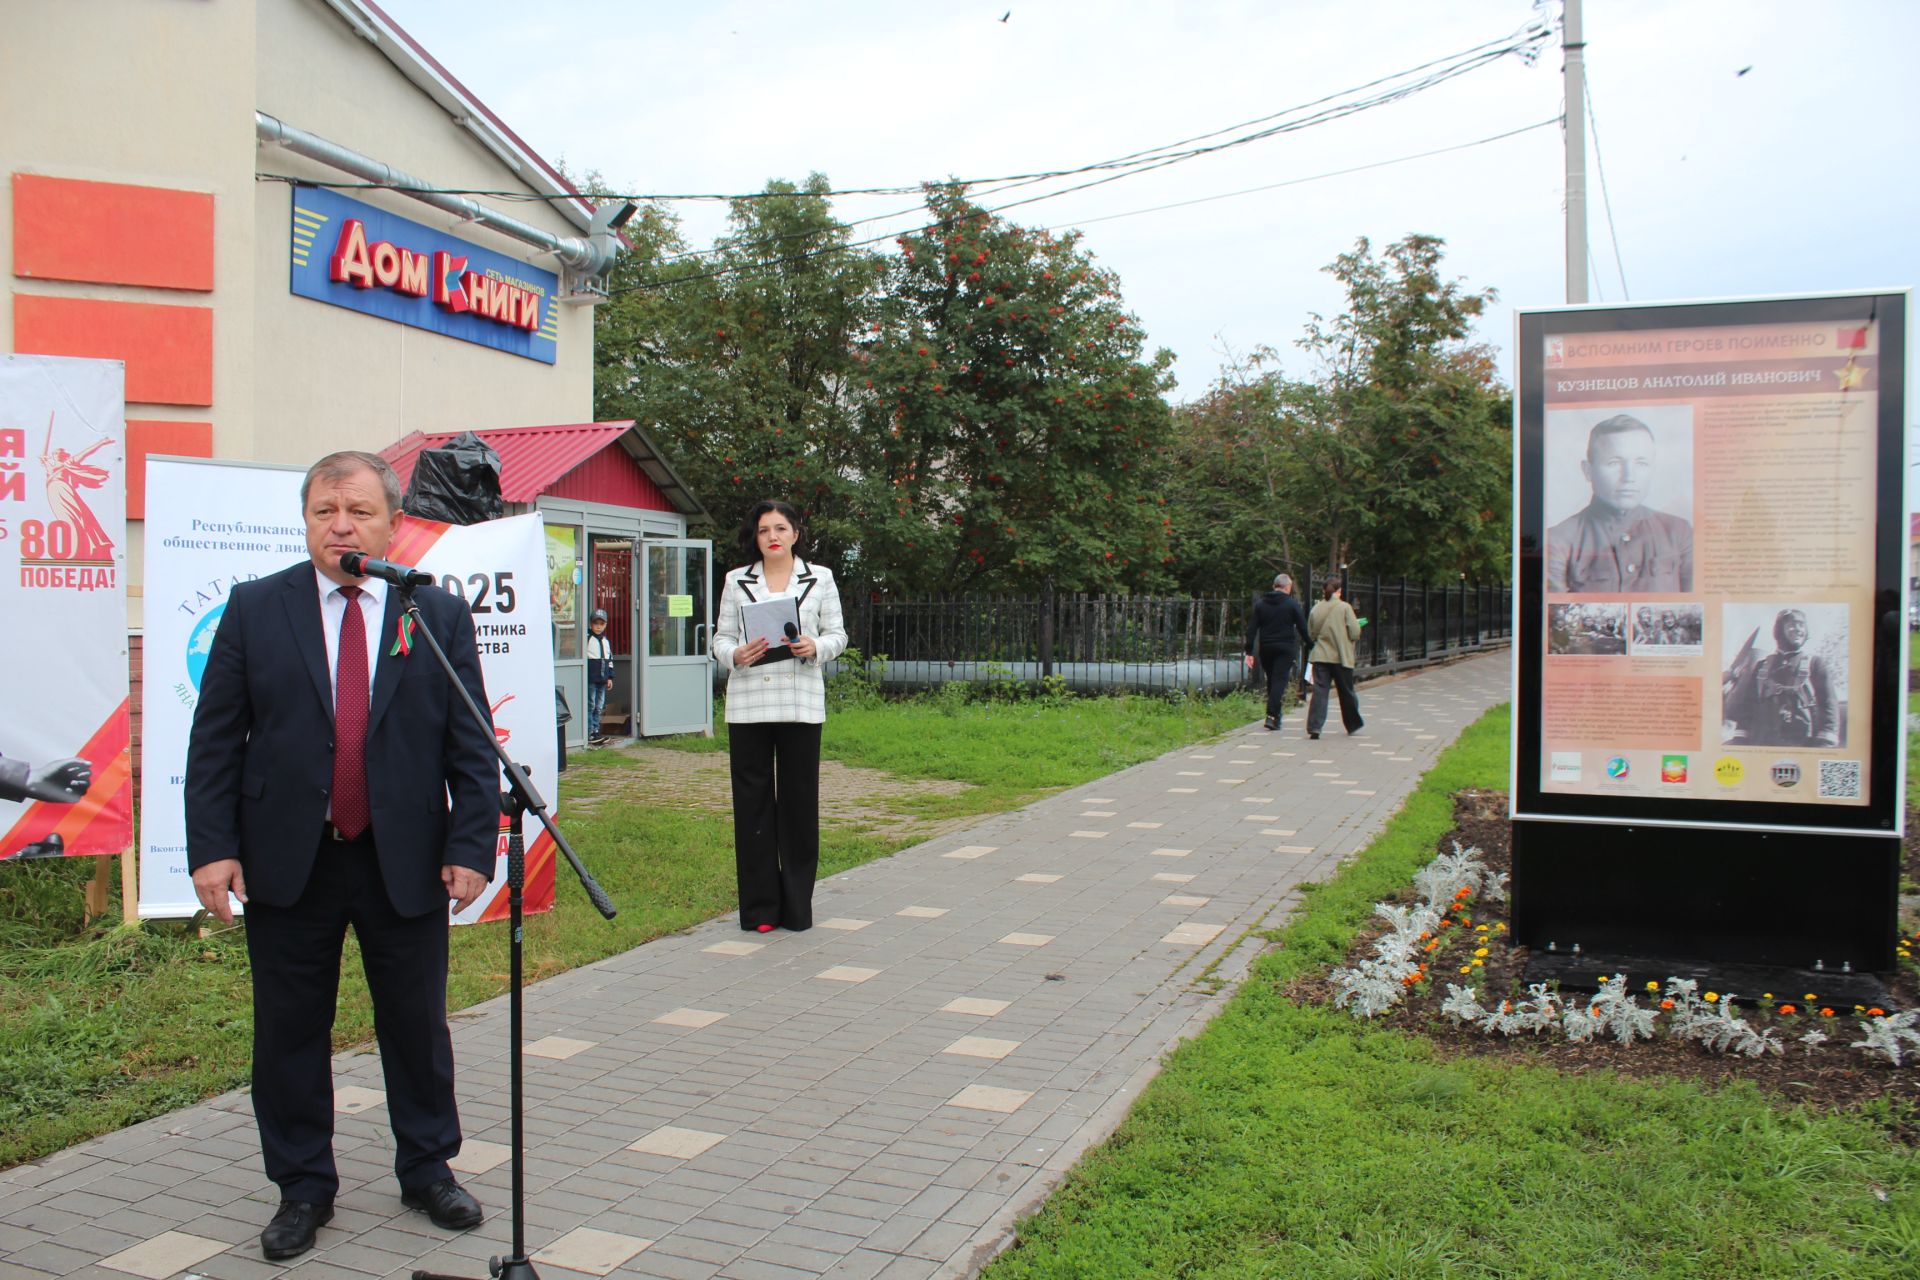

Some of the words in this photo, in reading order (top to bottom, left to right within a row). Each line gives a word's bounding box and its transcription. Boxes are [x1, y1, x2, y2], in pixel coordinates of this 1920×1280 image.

[486, 268, 504, 284] СЕТЬ
[505, 274, 545, 297] МАГАЗИНОВ
[1567, 341, 1663, 358] ВСПОМНИМ
[1667, 337, 1724, 353] ГЕРОЕВ
[1728, 333, 1826, 351] ПОИМЕННО
[1557, 377, 1640, 393] КУЗНЕЦОВ
[1642, 371, 1727, 390] АНАТОЛИЙ
[1731, 369, 1822, 385] ИВАНОВИЧ
[20, 519, 72, 560] 80
[192, 519, 307, 536] Республиканск
[163, 536, 271, 552] общественное
[20, 567, 116, 592] ПОБЕДА!
[420, 572, 515, 614] 025
[475, 624, 526, 637] итника
[477, 641, 509, 655] ства
